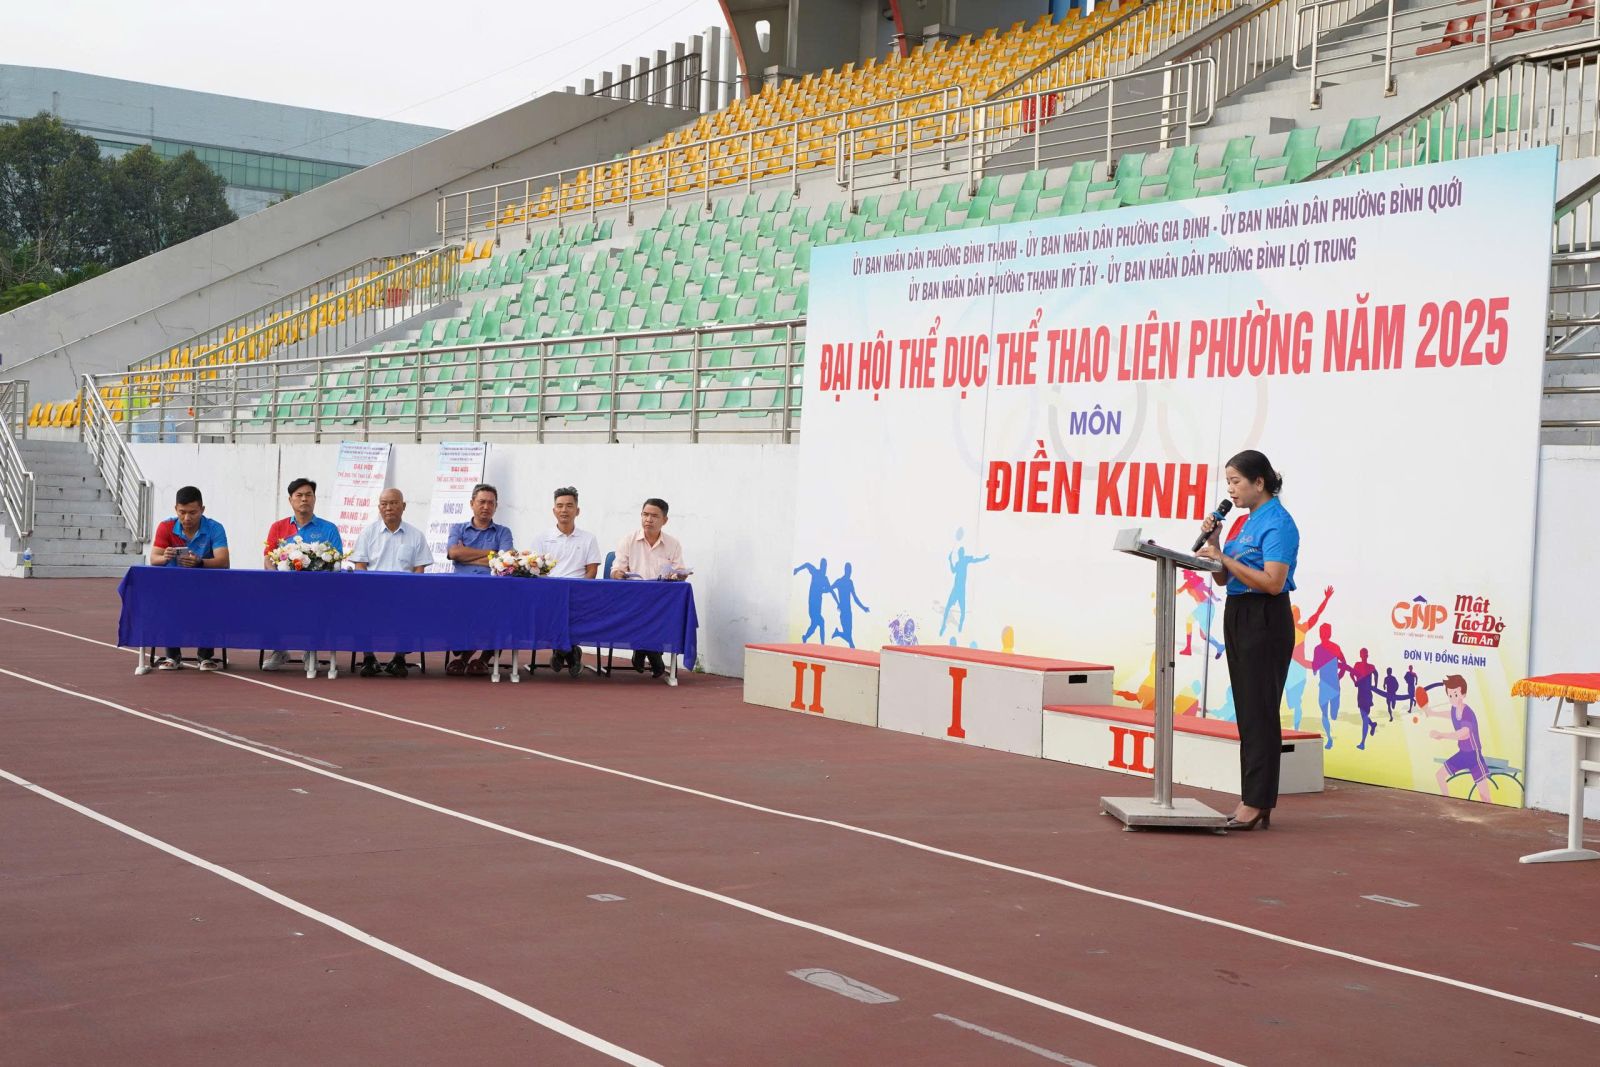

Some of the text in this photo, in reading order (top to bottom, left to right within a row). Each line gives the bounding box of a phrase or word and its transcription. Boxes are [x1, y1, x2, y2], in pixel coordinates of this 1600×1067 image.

[853, 251, 863, 276] ỦY
[865, 255, 881, 274] BAN
[883, 249, 906, 272] NHÂN
[907, 246, 924, 271] DÂN
[927, 244, 961, 268] PHƯỜNG
[963, 240, 984, 263] BÌNH
[987, 240, 1017, 265] THẠNH
[1026, 230, 1039, 257] ỦY
[1041, 234, 1060, 255] BAN
[1063, 227, 1090, 253] NHÂN
[1092, 224, 1113, 249] DÂN
[1116, 219, 1159, 247] PHƯỜNG
[1162, 220, 1179, 242] GIA
[1182, 216, 1210, 244] ĐỊNH
[1221, 205, 1238, 236] ỦY
[1238, 209, 1262, 234] BAN
[1266, 200, 1299, 230] NHÂN
[1302, 195, 1328, 225] DÂN
[1332, 189, 1386, 221] PHƯỜNG
[1390, 184, 1424, 214] BÌNH
[1428, 175, 1463, 213] QUỚI
[909, 276, 921, 301] ỦY
[922, 281, 940, 301] BAN
[941, 274, 965, 299] NHÂN
[967, 271, 986, 296] DÂN
[988, 269, 1024, 294] PHƯỜNG
[1027, 270, 1058, 294] THẠNH
[1061, 263, 1077, 288] MỸ
[1079, 260, 1099, 287] TÂY
[1107, 255, 1122, 284] ỦY
[1124, 260, 1146, 282] BAN
[1148, 253, 1178, 280] NHÂN
[1181, 250, 1204, 277] DÂN
[1207, 246, 1253, 274] PHƯỜNG
[1257, 241, 1285, 270] BÌNH
[1290, 239, 1310, 270] LỢI
[1314, 236, 1357, 264] TRUNG
[820, 292, 1510, 402] ĐẠI HỘI THỂ DỤC THỂ THAO LIÊN PHƯỜNG NĂM 2025
[1069, 404, 1122, 435] MÔN
[986, 439, 1208, 520] ĐIỀN KINH
[1404, 649, 1486, 667] ĐƠN VỊ ĐỒNG HÀNH
[1456, 632, 1478, 644] Tâm
[790, 660, 826, 714] II
[947, 666, 967, 739] I
